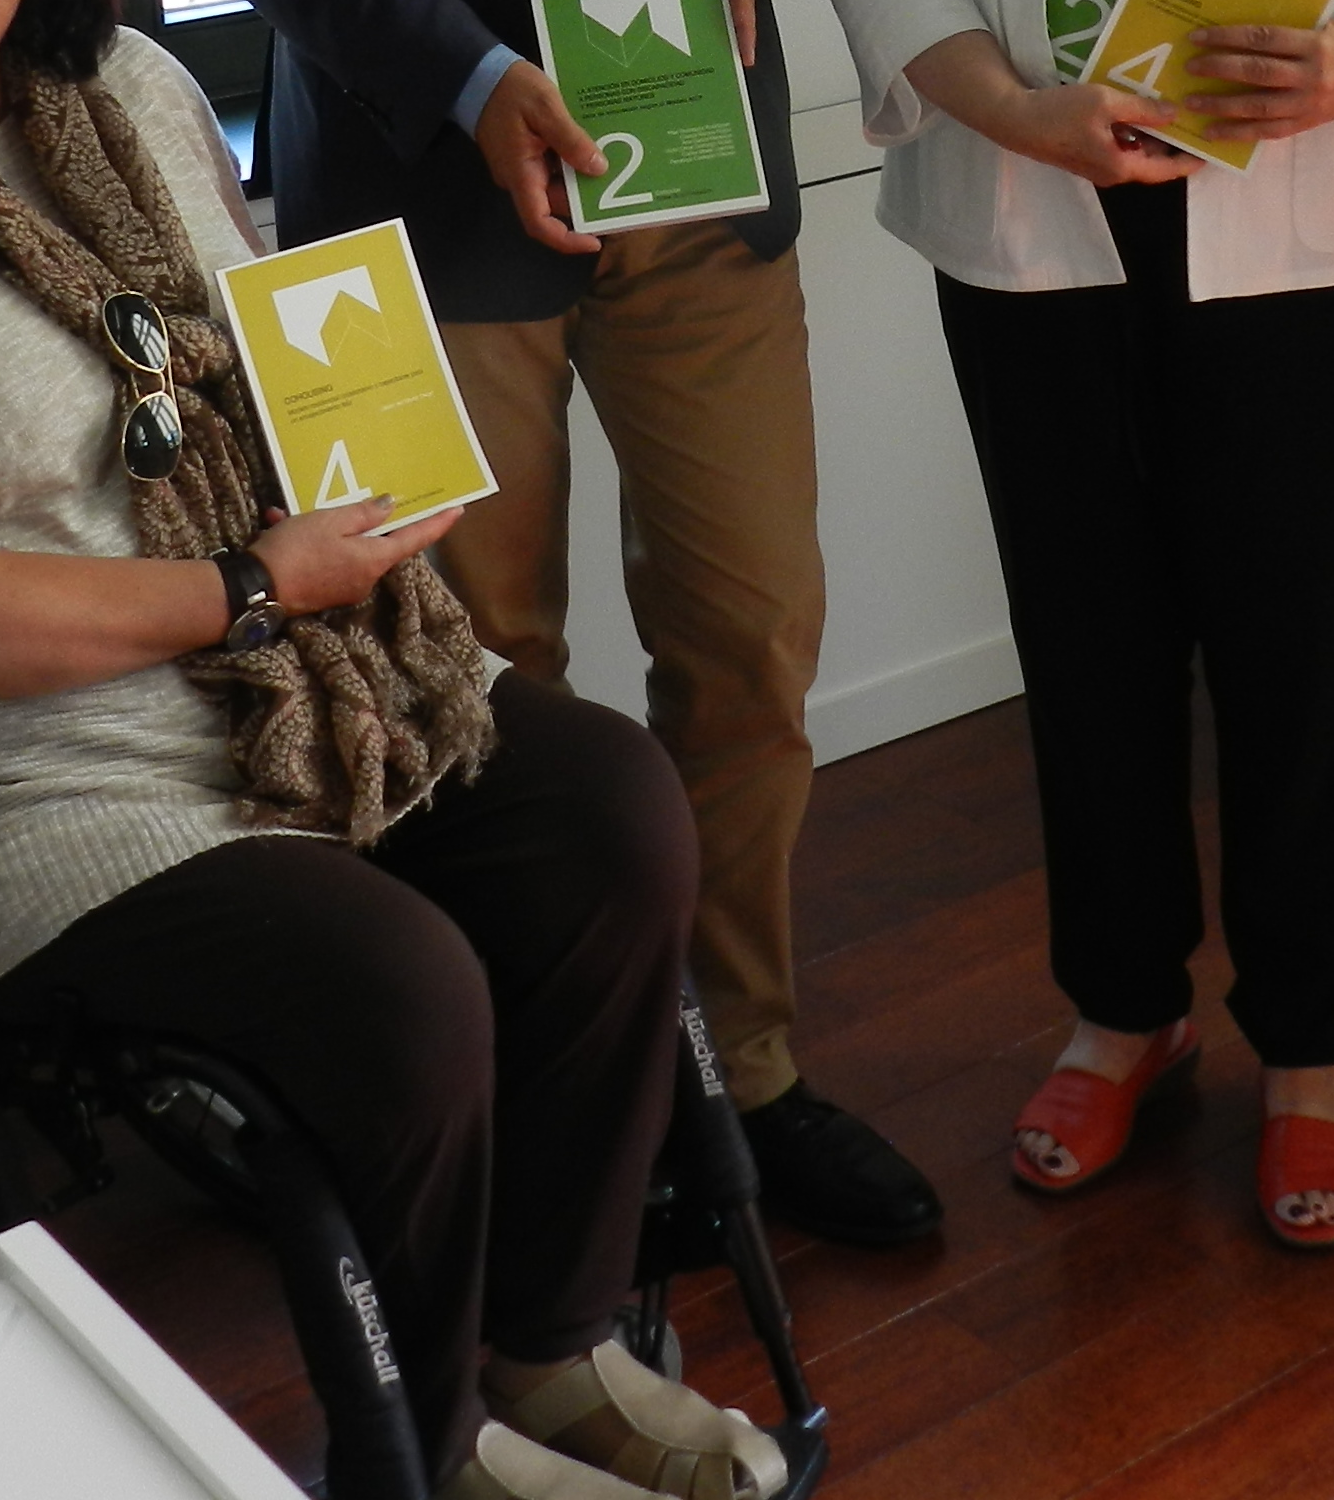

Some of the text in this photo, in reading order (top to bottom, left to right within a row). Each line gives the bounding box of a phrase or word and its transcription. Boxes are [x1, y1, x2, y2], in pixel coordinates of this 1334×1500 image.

[1105, 42, 1174, 100] 4
[594, 131, 654, 210] 2
[313, 438, 374, 511] 4
